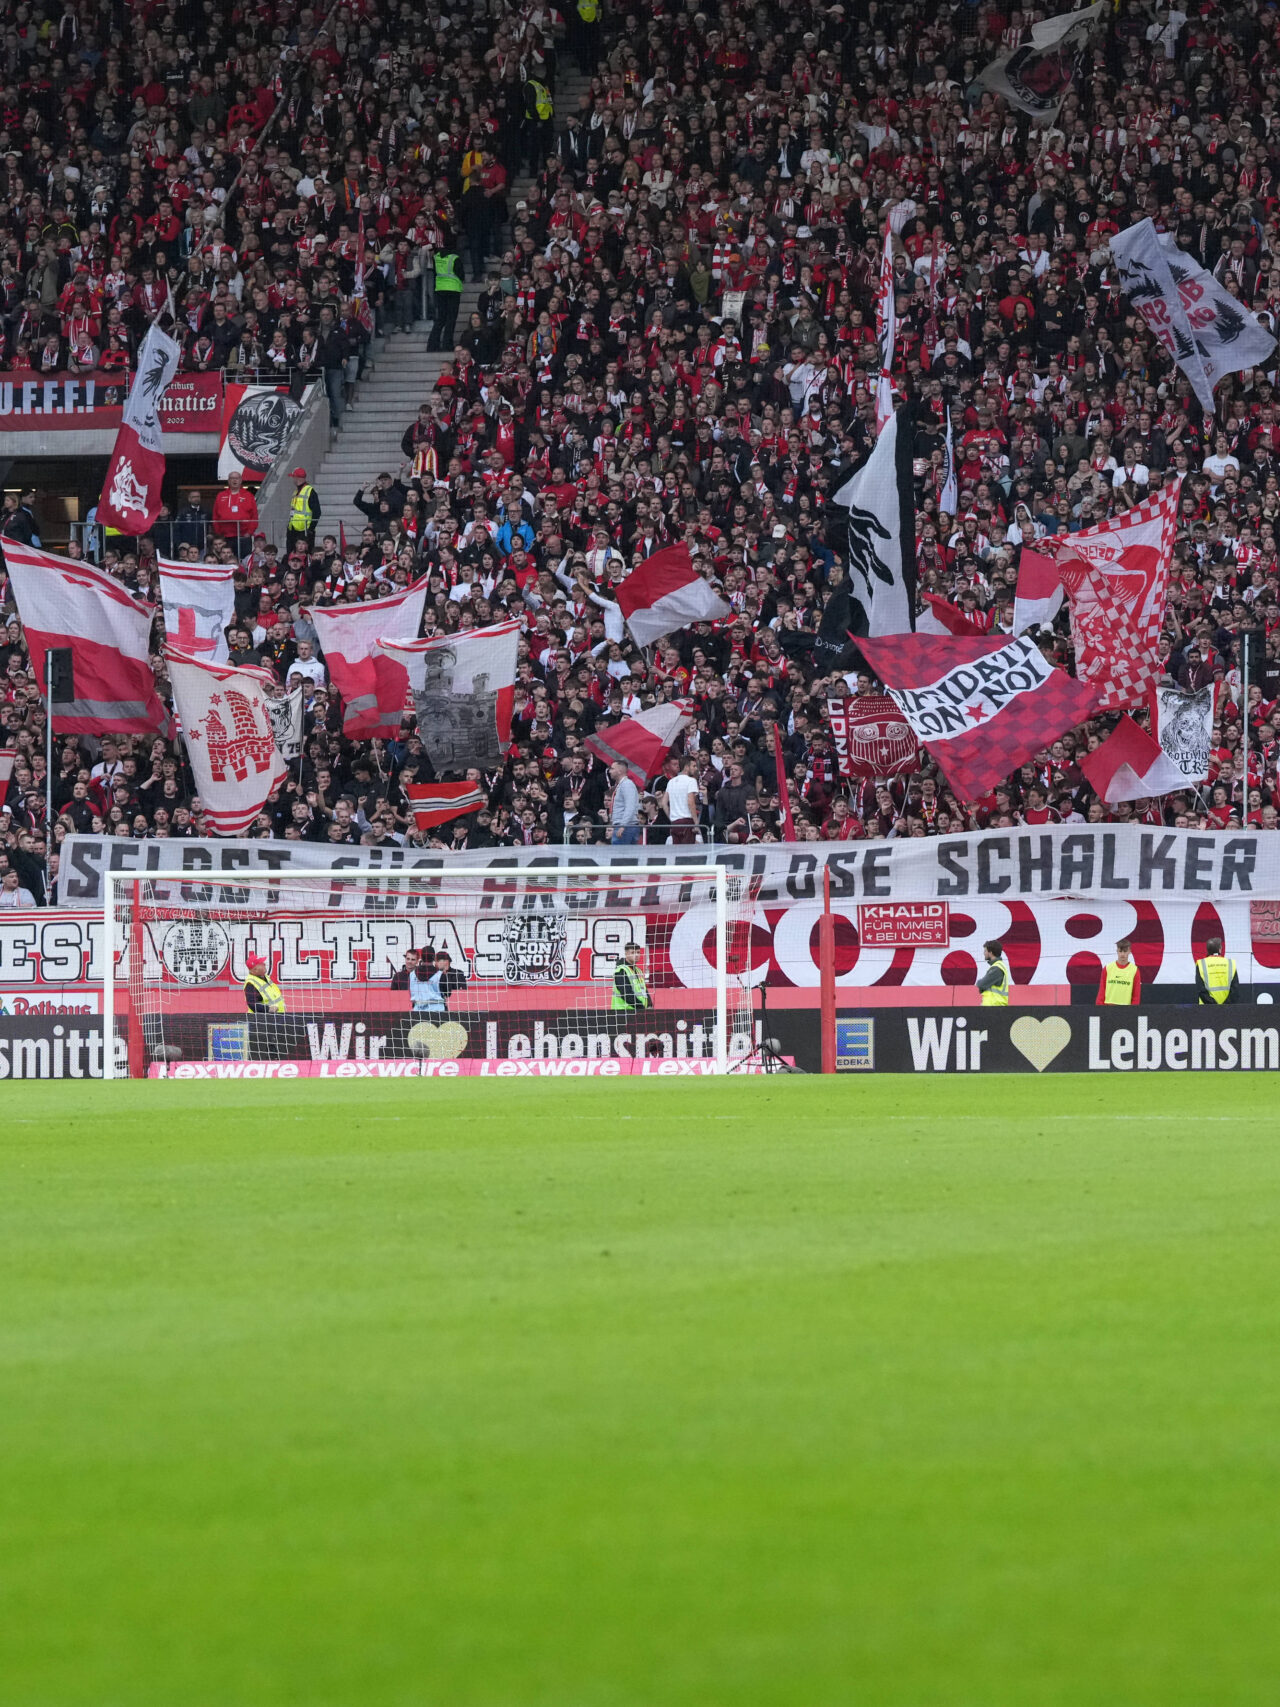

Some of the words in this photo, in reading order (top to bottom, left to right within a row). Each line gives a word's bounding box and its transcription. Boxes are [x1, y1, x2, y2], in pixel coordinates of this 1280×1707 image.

[167, 382, 194, 391] reiburg
[979, 658, 1045, 710] NOI
[210, 744, 275, 765] SYNTHES
[67, 842, 291, 904] SELBST
[327, 849, 444, 910] FÜR
[479, 847, 893, 910] ARBEITSLOSE
[937, 832, 1257, 897] SCHALKER
[863, 904, 943, 919] KHALID
[863, 919, 893, 931] FÜR
[896, 920, 943, 931] IMMER
[875, 932, 897, 941] BEI
[900, 931, 932, 941] UNS
[516, 943, 552, 954] CON
[518, 954, 551, 967] NOI
[13, 996, 92, 1015] Rothaus
[307, 1022, 387, 1060] Wir
[906, 1015, 988, 1071] Wir
[159, 1063, 299, 1079] Lexware
[320, 1062, 459, 1078] Lexware
[480, 1061, 621, 1077] Lexware
